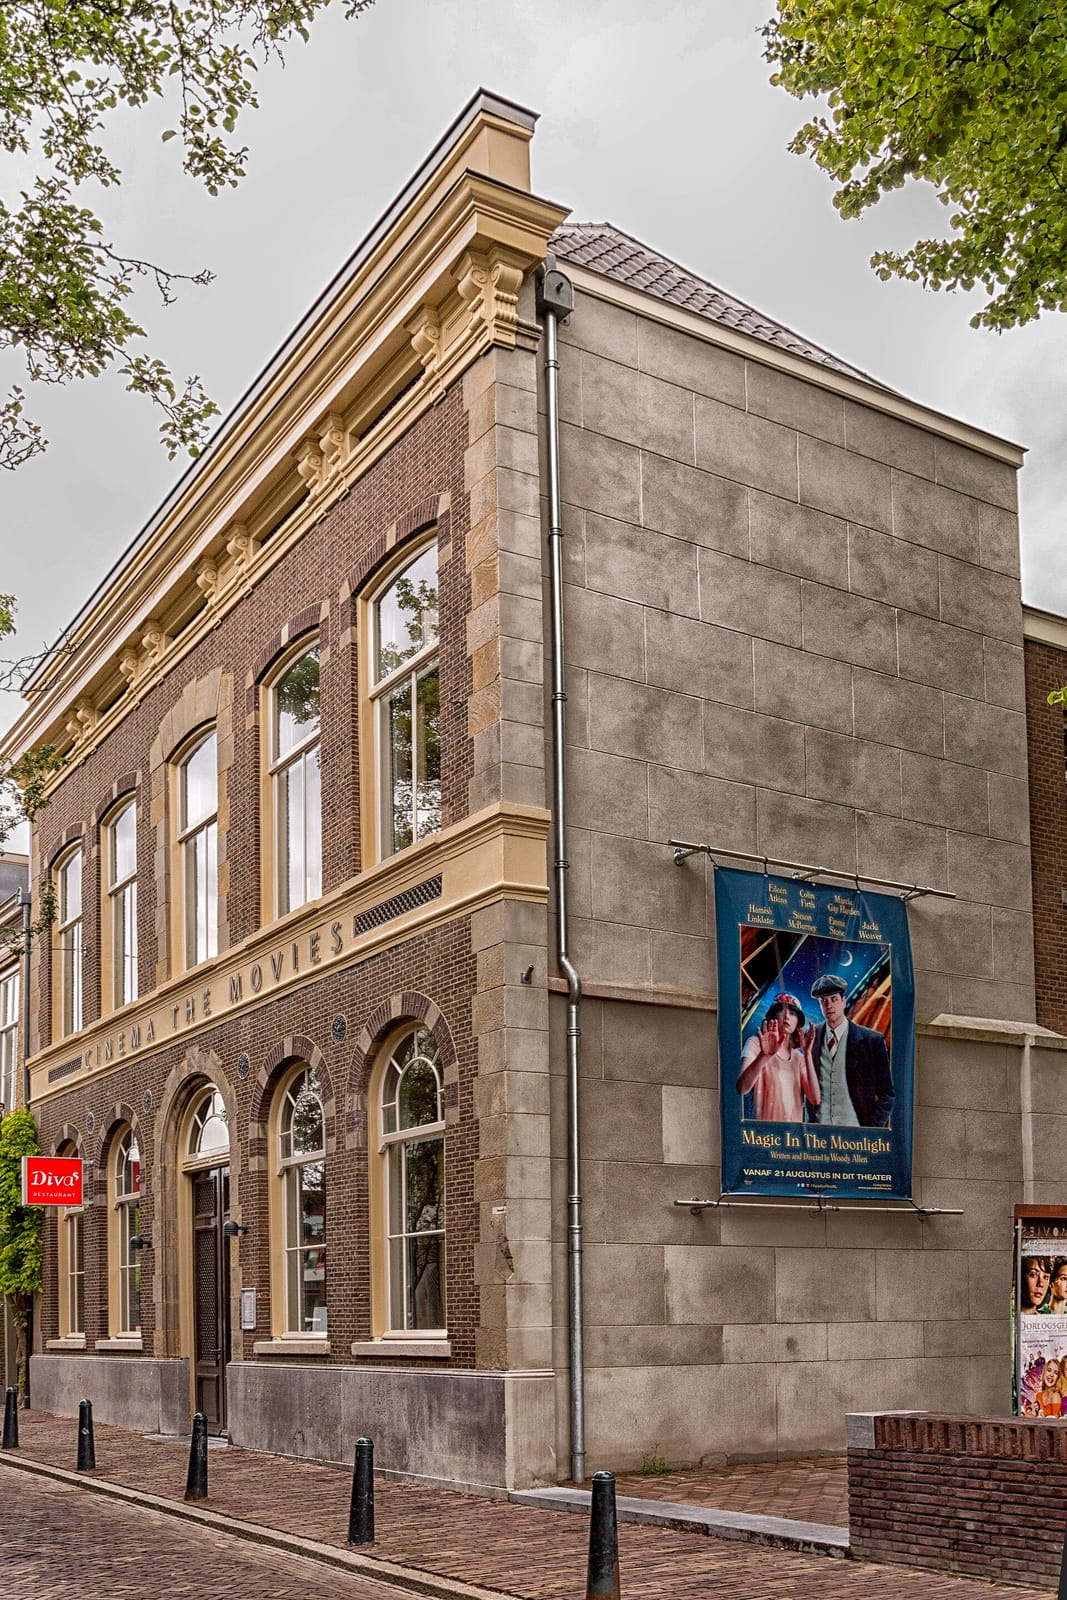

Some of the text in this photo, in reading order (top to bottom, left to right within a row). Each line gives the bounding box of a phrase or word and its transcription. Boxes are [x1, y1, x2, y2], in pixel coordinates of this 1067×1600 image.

[800, 889, 815, 900] Colin
[801, 898, 815, 909] Firth
[747, 912, 774, 925] Linklater
[792, 910, 812, 921] Simon
[859, 930, 882, 940] Weaver
[81, 921, 343, 1073] CINEMA THE MOVIES
[742, 1130, 891, 1153] Magic In The Moonlight
[770, 1151, 791, 1160] Written
[803, 1152, 824, 1162] Directed
[830, 1153, 850, 1164] Woody
[852, 1153, 868, 1163] Allen
[31, 1170, 80, 1187] Divas
[743, 1168, 771, 1176] VANAF
[786, 1170, 831, 1179] AUGUSTUS
[832, 1172, 841, 1180] IN
[857, 1173, 892, 1181] THEATER
